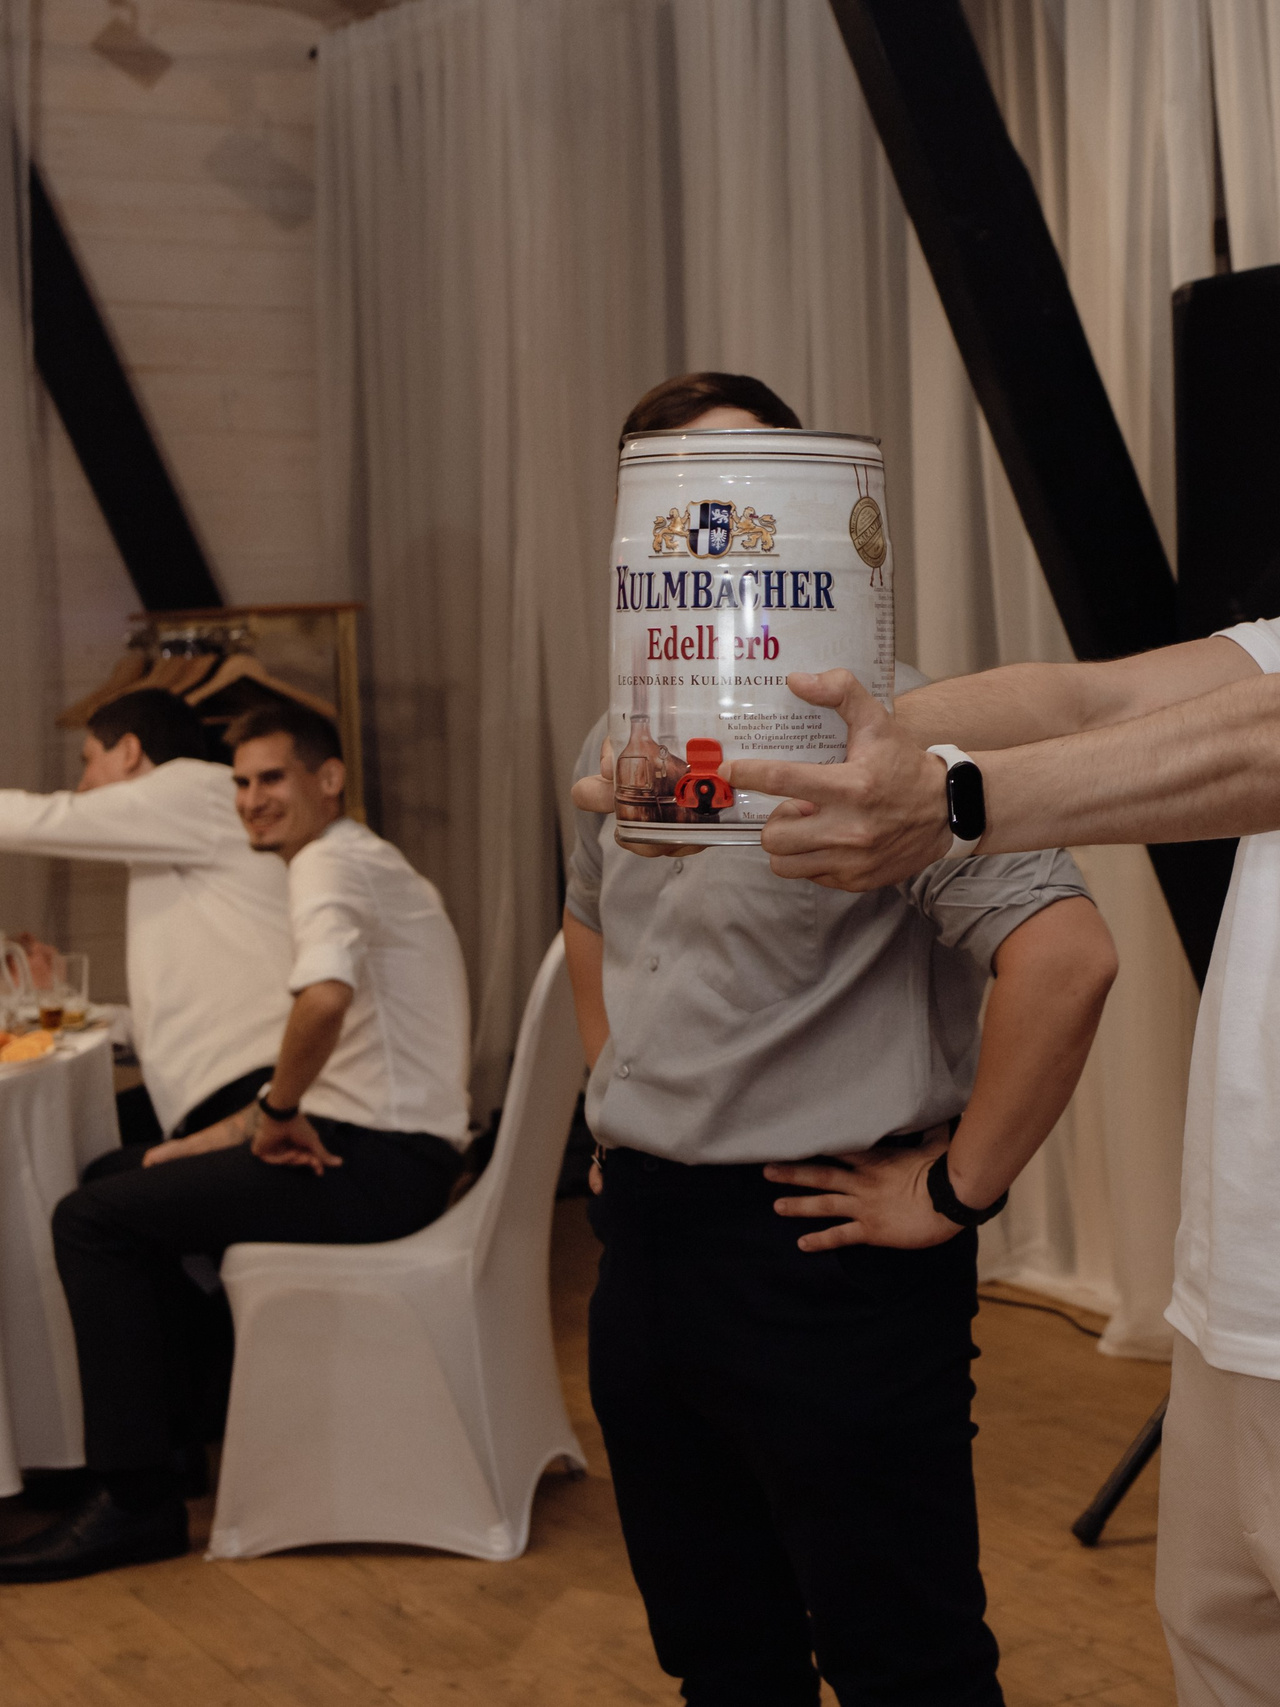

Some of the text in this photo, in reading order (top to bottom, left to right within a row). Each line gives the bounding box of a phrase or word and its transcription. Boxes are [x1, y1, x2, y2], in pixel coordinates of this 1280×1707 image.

[616, 565, 835, 610] KULMBACHER
[647, 624, 780, 660] Edelherb
[618, 673, 685, 686] LEGENDÄRES
[754, 733, 808, 741] Originalrezept
[810, 733, 838, 741] gebraut.
[752, 743, 794, 751] Erinnerung
[806, 742, 817, 750] die
[742, 811, 755, 819] Mit
